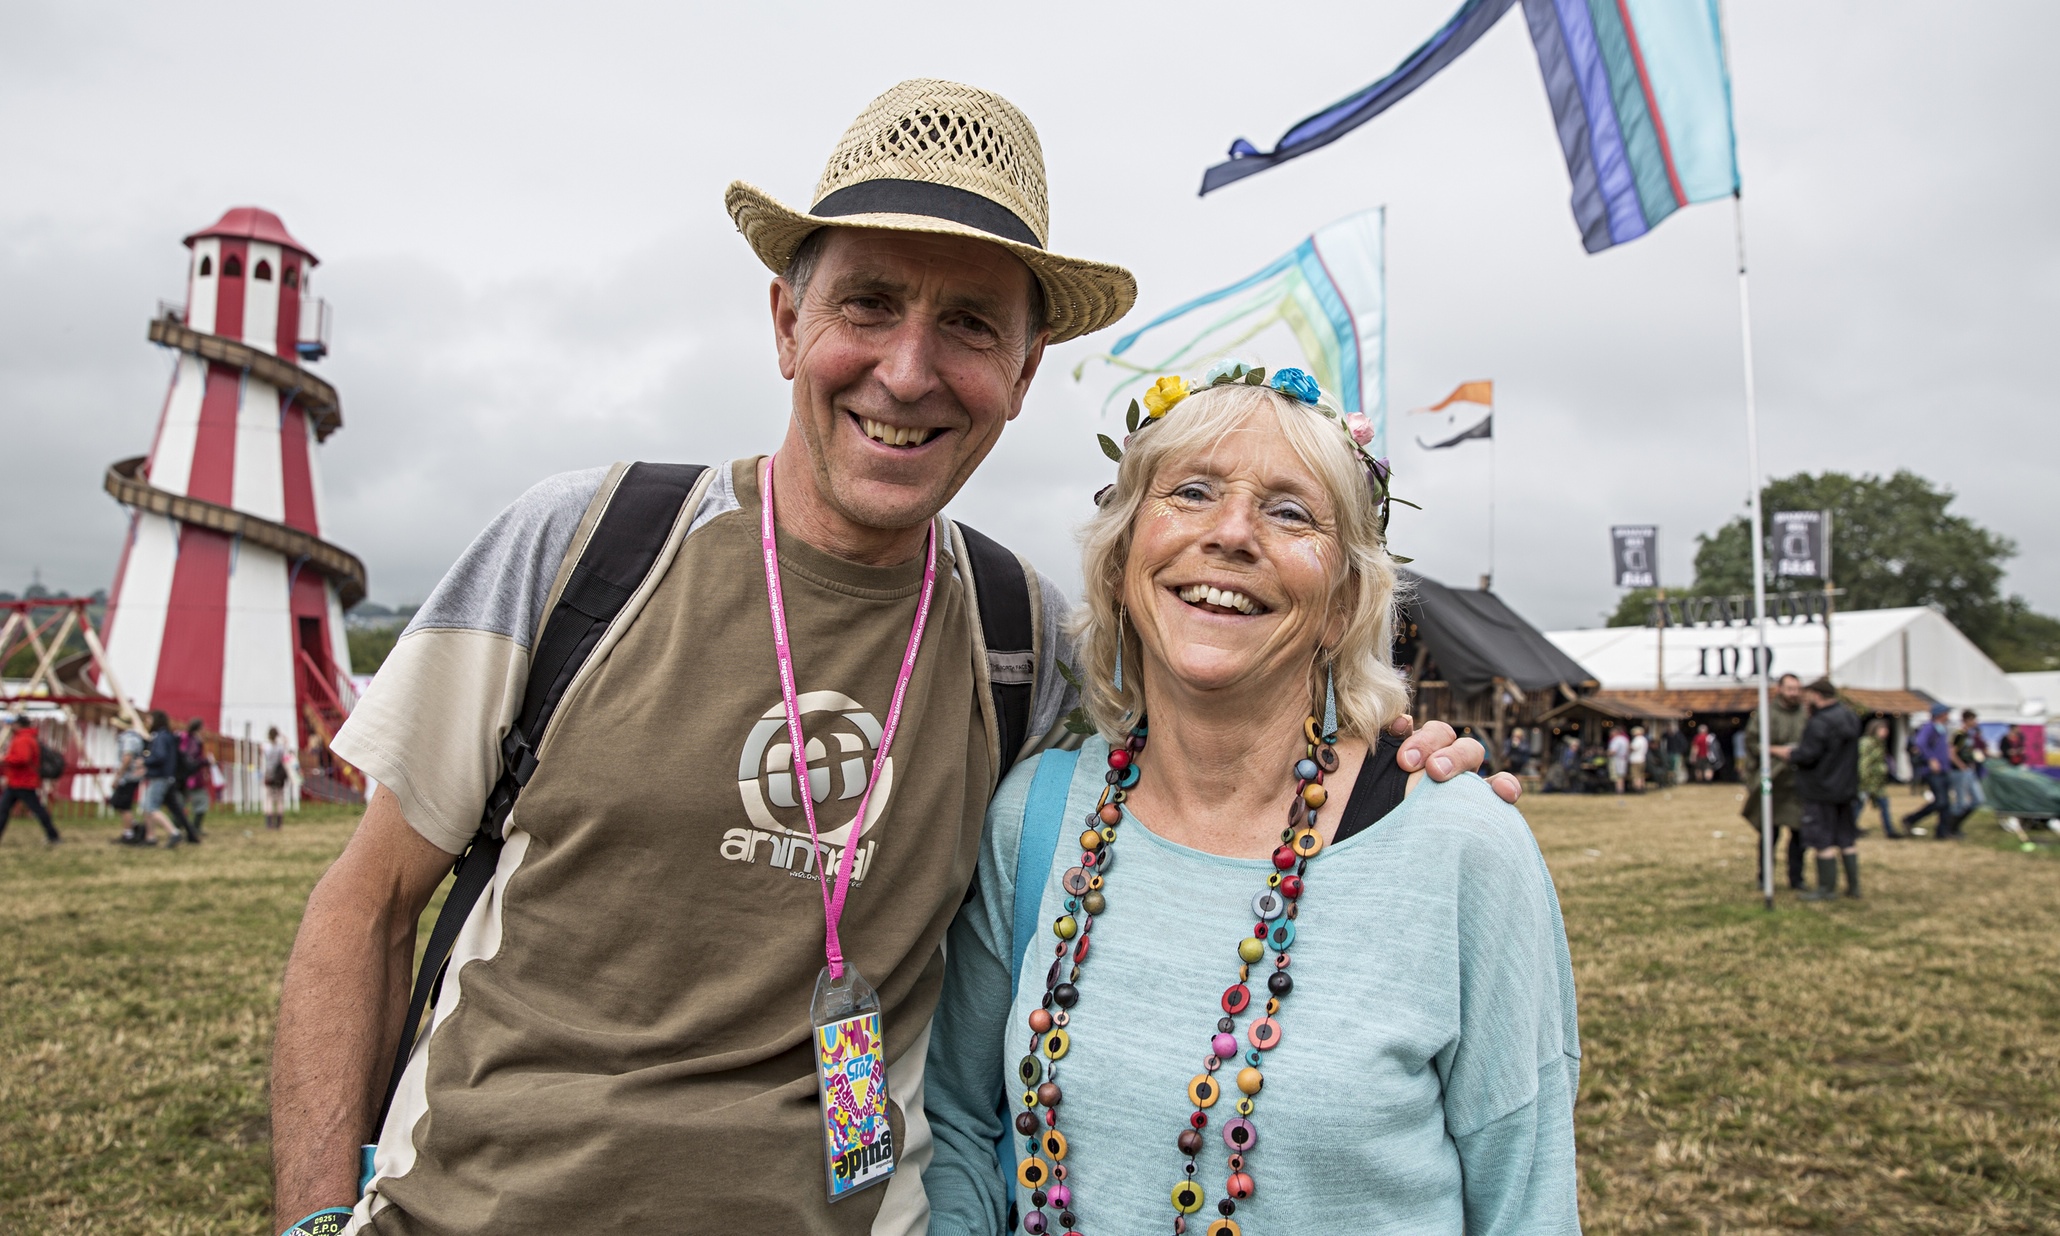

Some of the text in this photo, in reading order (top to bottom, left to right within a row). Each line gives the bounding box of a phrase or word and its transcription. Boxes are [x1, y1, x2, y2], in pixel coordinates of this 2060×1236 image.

[766, 548, 785, 646] theguardian.com/glastonbury
[907, 579, 933, 666] theguardian.com/glastonbury
[780, 658, 802, 763] theguardian.com/glastonbury
[876, 676, 909, 770] theguardian.com/glastonbury
[846, 1053, 875, 1082] 2015
[835, 1129, 892, 1180] guide
